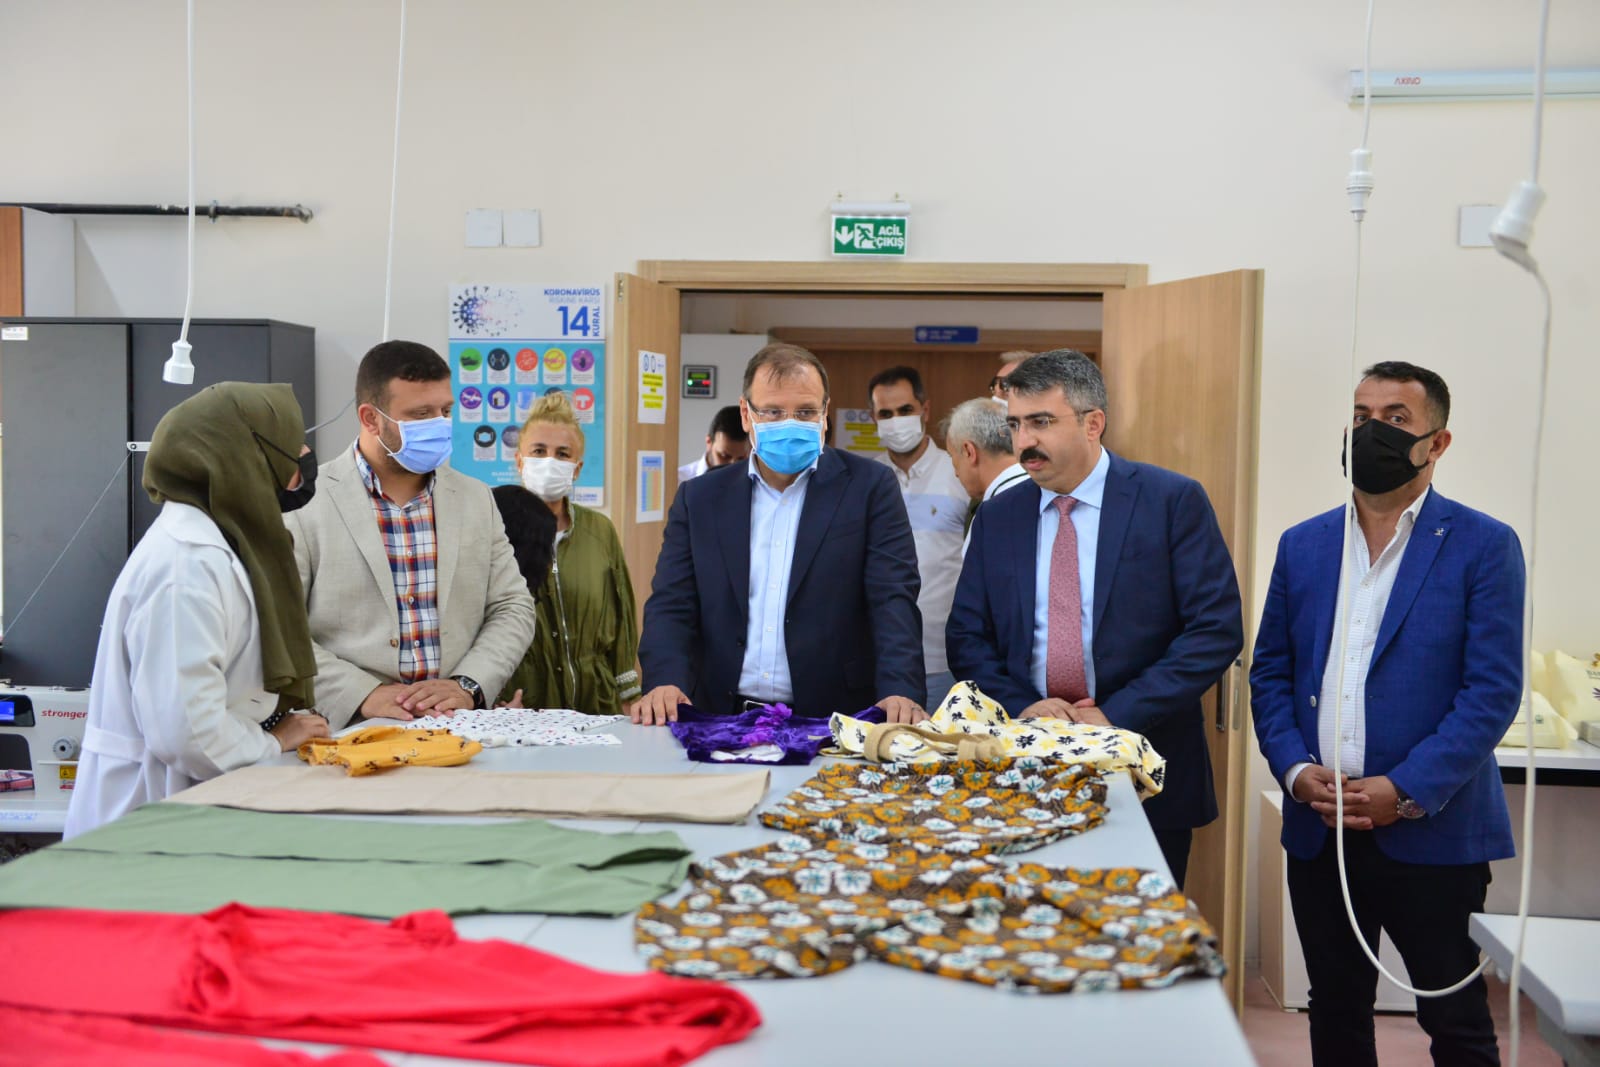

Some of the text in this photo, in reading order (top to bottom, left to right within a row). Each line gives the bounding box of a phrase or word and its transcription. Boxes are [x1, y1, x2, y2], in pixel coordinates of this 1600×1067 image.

[878, 224, 903, 236] ACİL
[876, 237, 904, 250] ÇIKIŞ
[543, 287, 600, 296] KORONAVİRÜS
[556, 305, 591, 337] 14
[592, 306, 601, 337] KURAL
[41, 709, 88, 721] stronger
